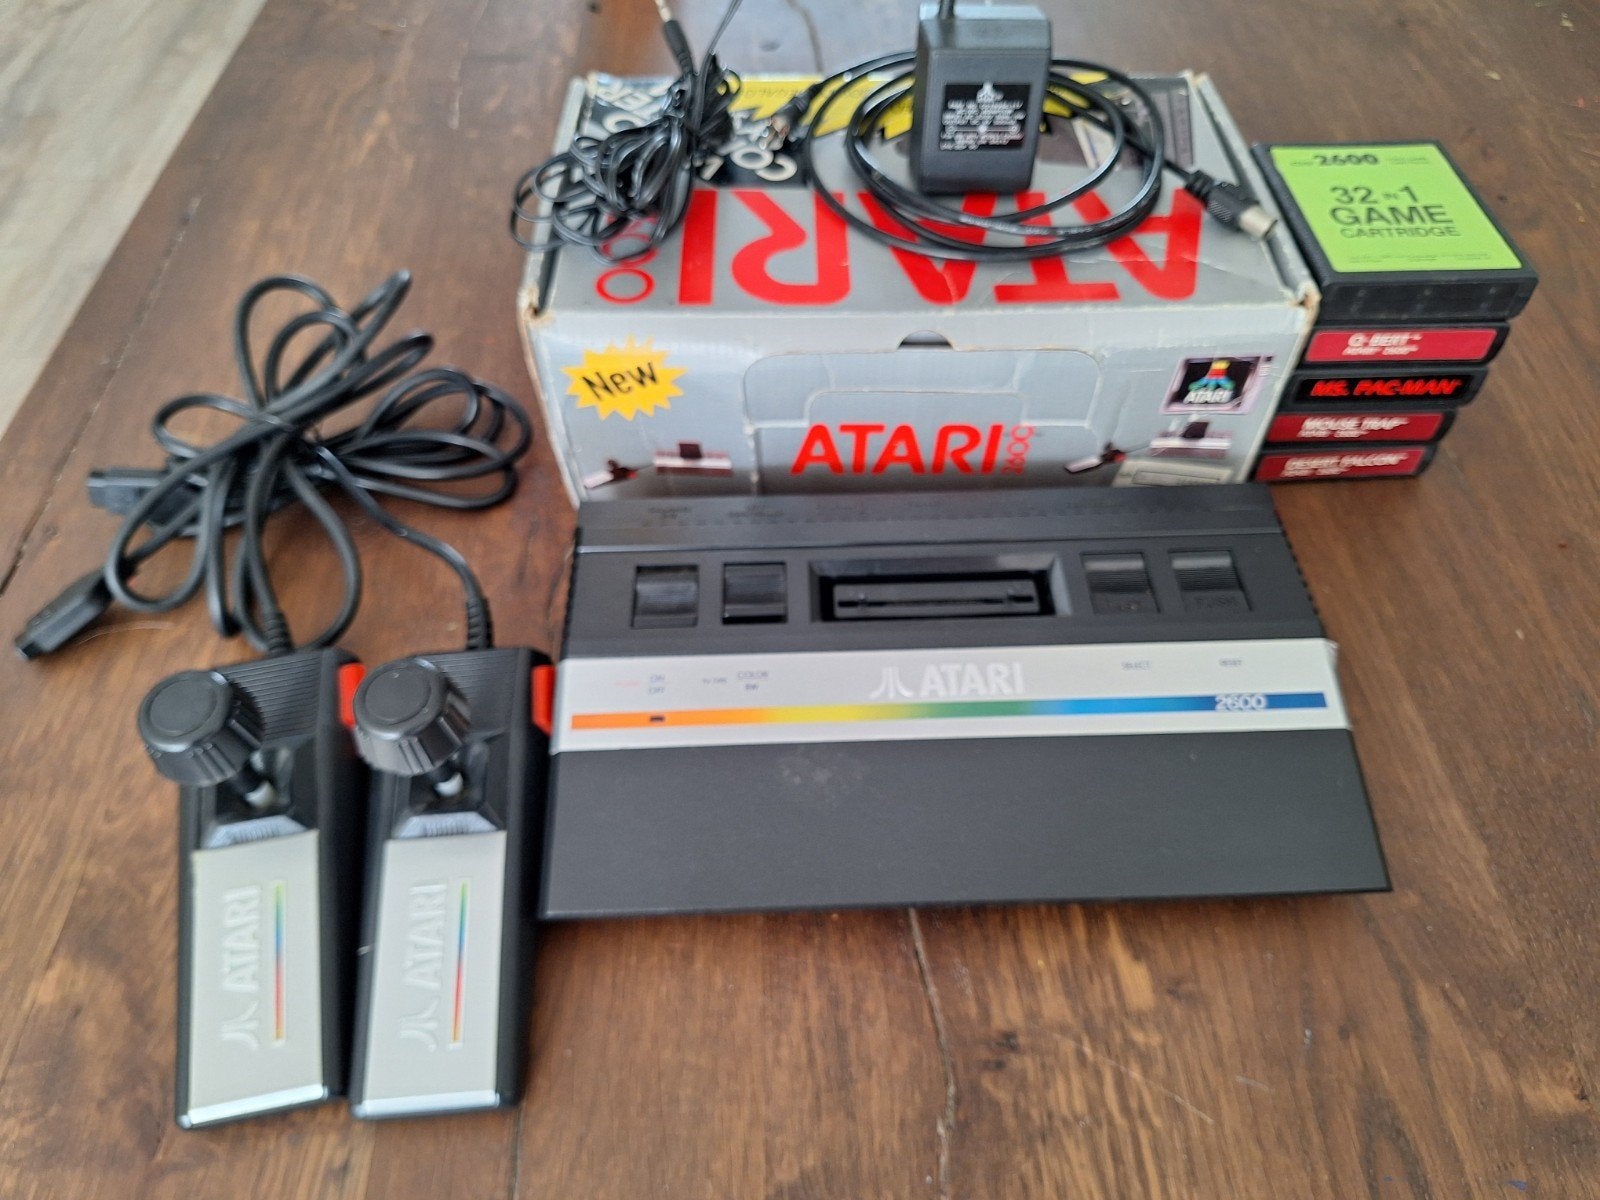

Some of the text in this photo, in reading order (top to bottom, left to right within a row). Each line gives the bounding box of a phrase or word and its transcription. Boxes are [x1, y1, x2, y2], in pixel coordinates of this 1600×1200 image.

[1313, 154, 1379, 167] 2600
[1329, 186, 1378, 204] 32
[1328, 205, 1454, 226] GAME
[1341, 226, 1461, 239] CARTRIDGE
[1183, 387, 1234, 404] ATARI
[790, 423, 1004, 476] ATARI
[919, 661, 1025, 698] ATARI
[1214, 693, 1268, 712] 2600
[222, 884, 262, 993] ATARI
[404, 883, 448, 991] ATARI
